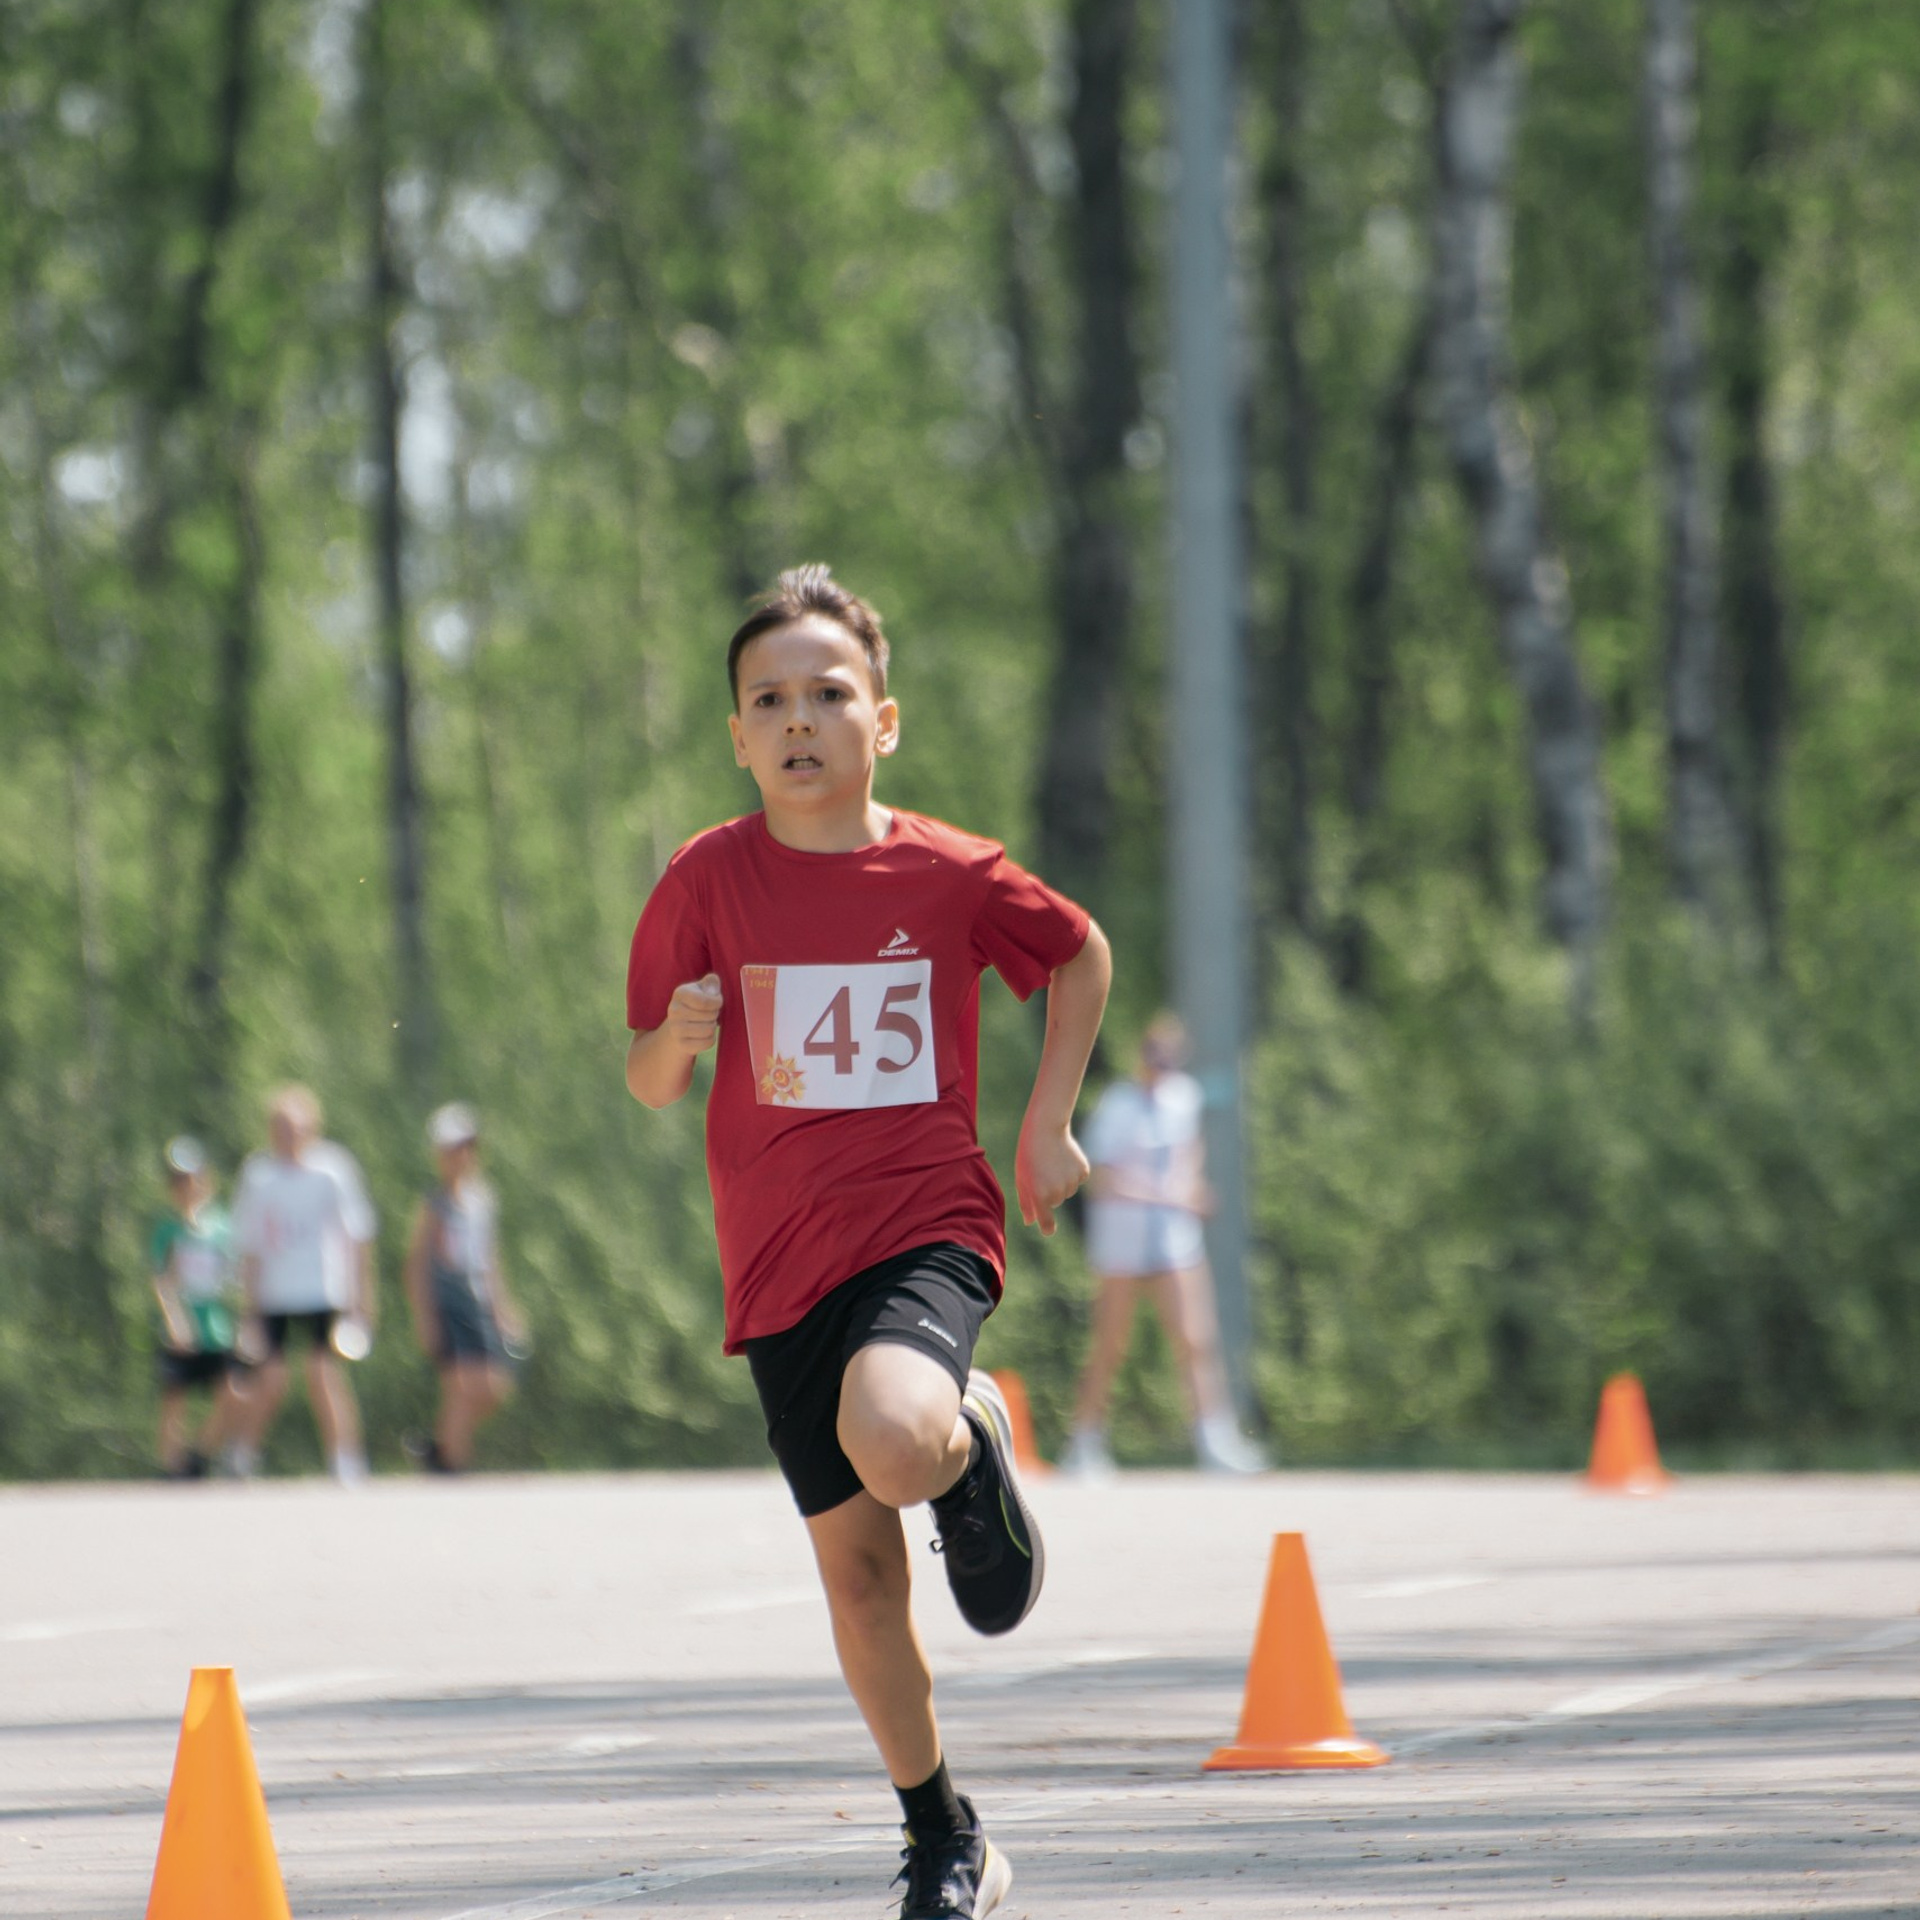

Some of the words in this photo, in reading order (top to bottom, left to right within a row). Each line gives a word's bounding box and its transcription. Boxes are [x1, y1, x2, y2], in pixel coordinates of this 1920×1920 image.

[877, 948, 919, 957] DEMIX
[750, 980, 774, 989] 1945
[803, 983, 923, 1075] 45
